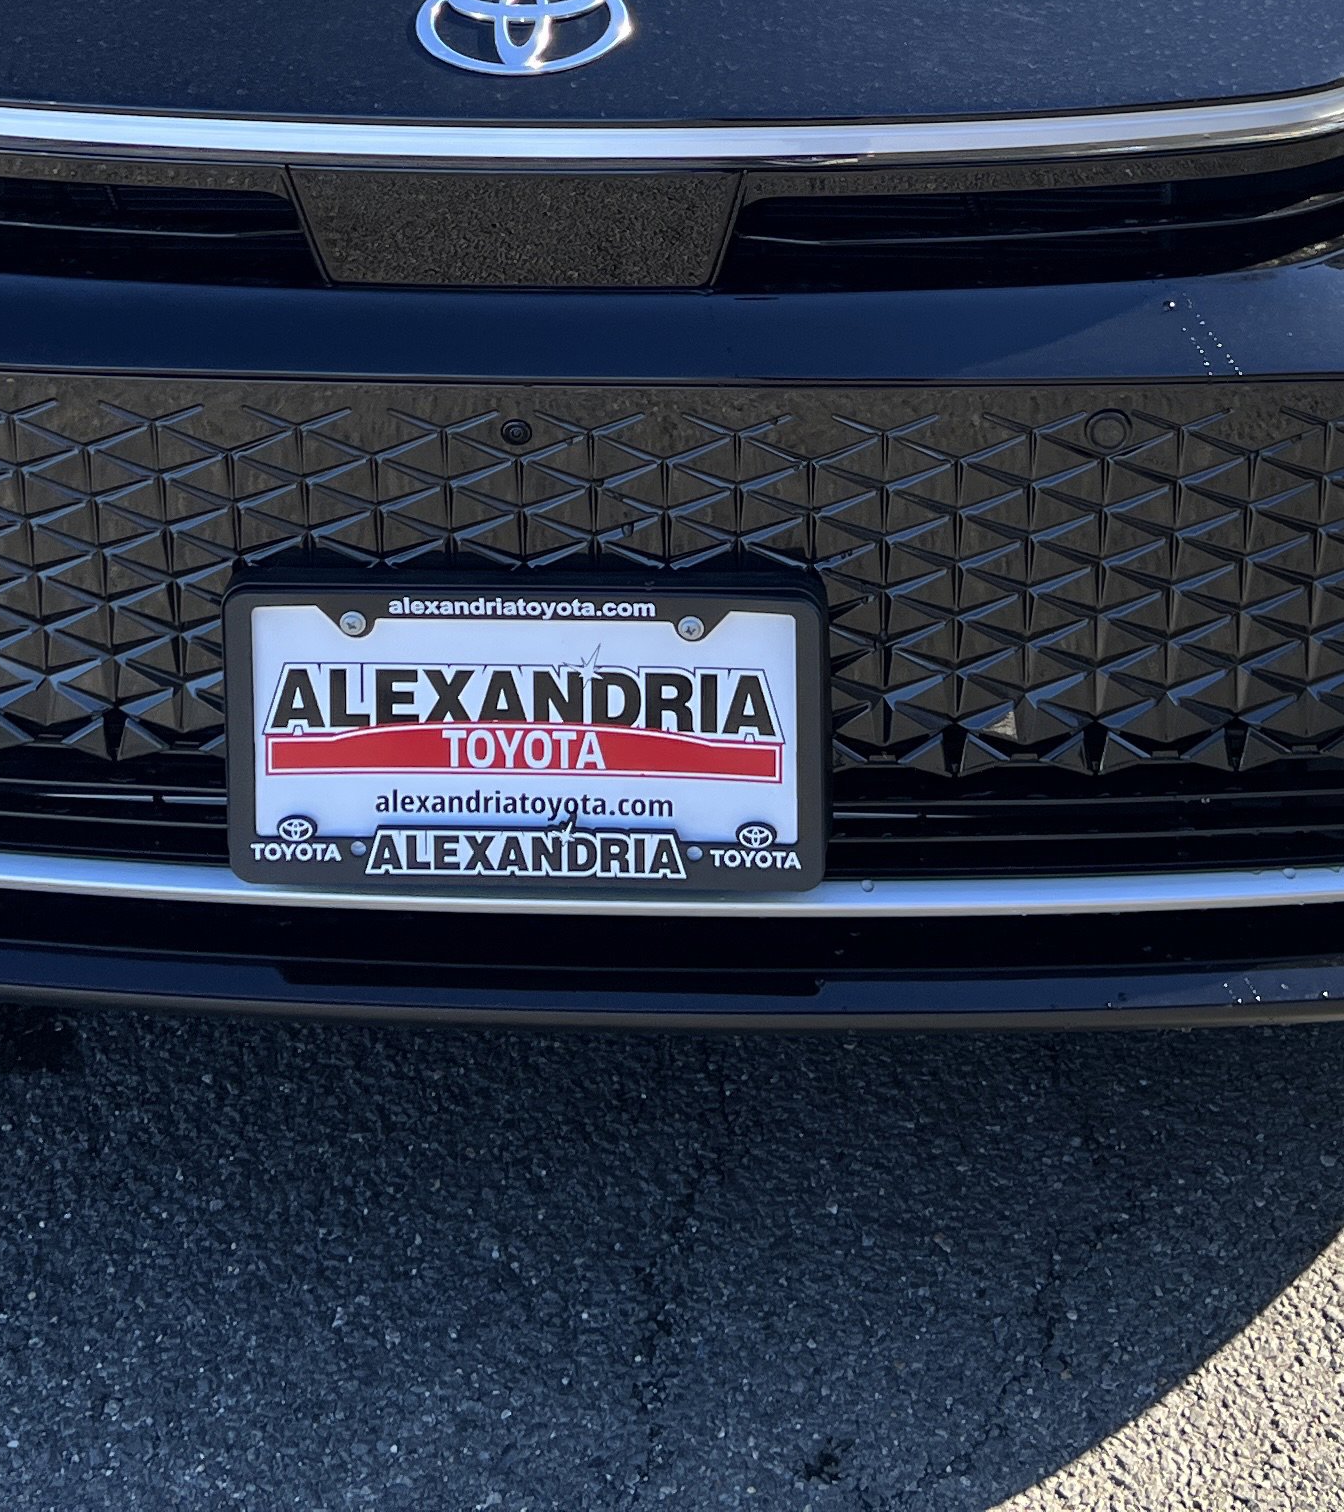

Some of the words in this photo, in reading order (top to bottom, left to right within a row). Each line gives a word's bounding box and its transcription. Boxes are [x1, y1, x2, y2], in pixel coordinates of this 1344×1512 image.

[388, 596, 657, 621] alexandriatoyota.com
[263, 663, 785, 743] ALEXANDRIA
[442, 729, 606, 770] TOYOTA
[375, 789, 674, 821] alexandriatoyota.com
[250, 842, 342, 863] TOYOTA
[365, 828, 687, 879] ALEXANDRIA
[709, 848, 803, 870] TOYOTA
